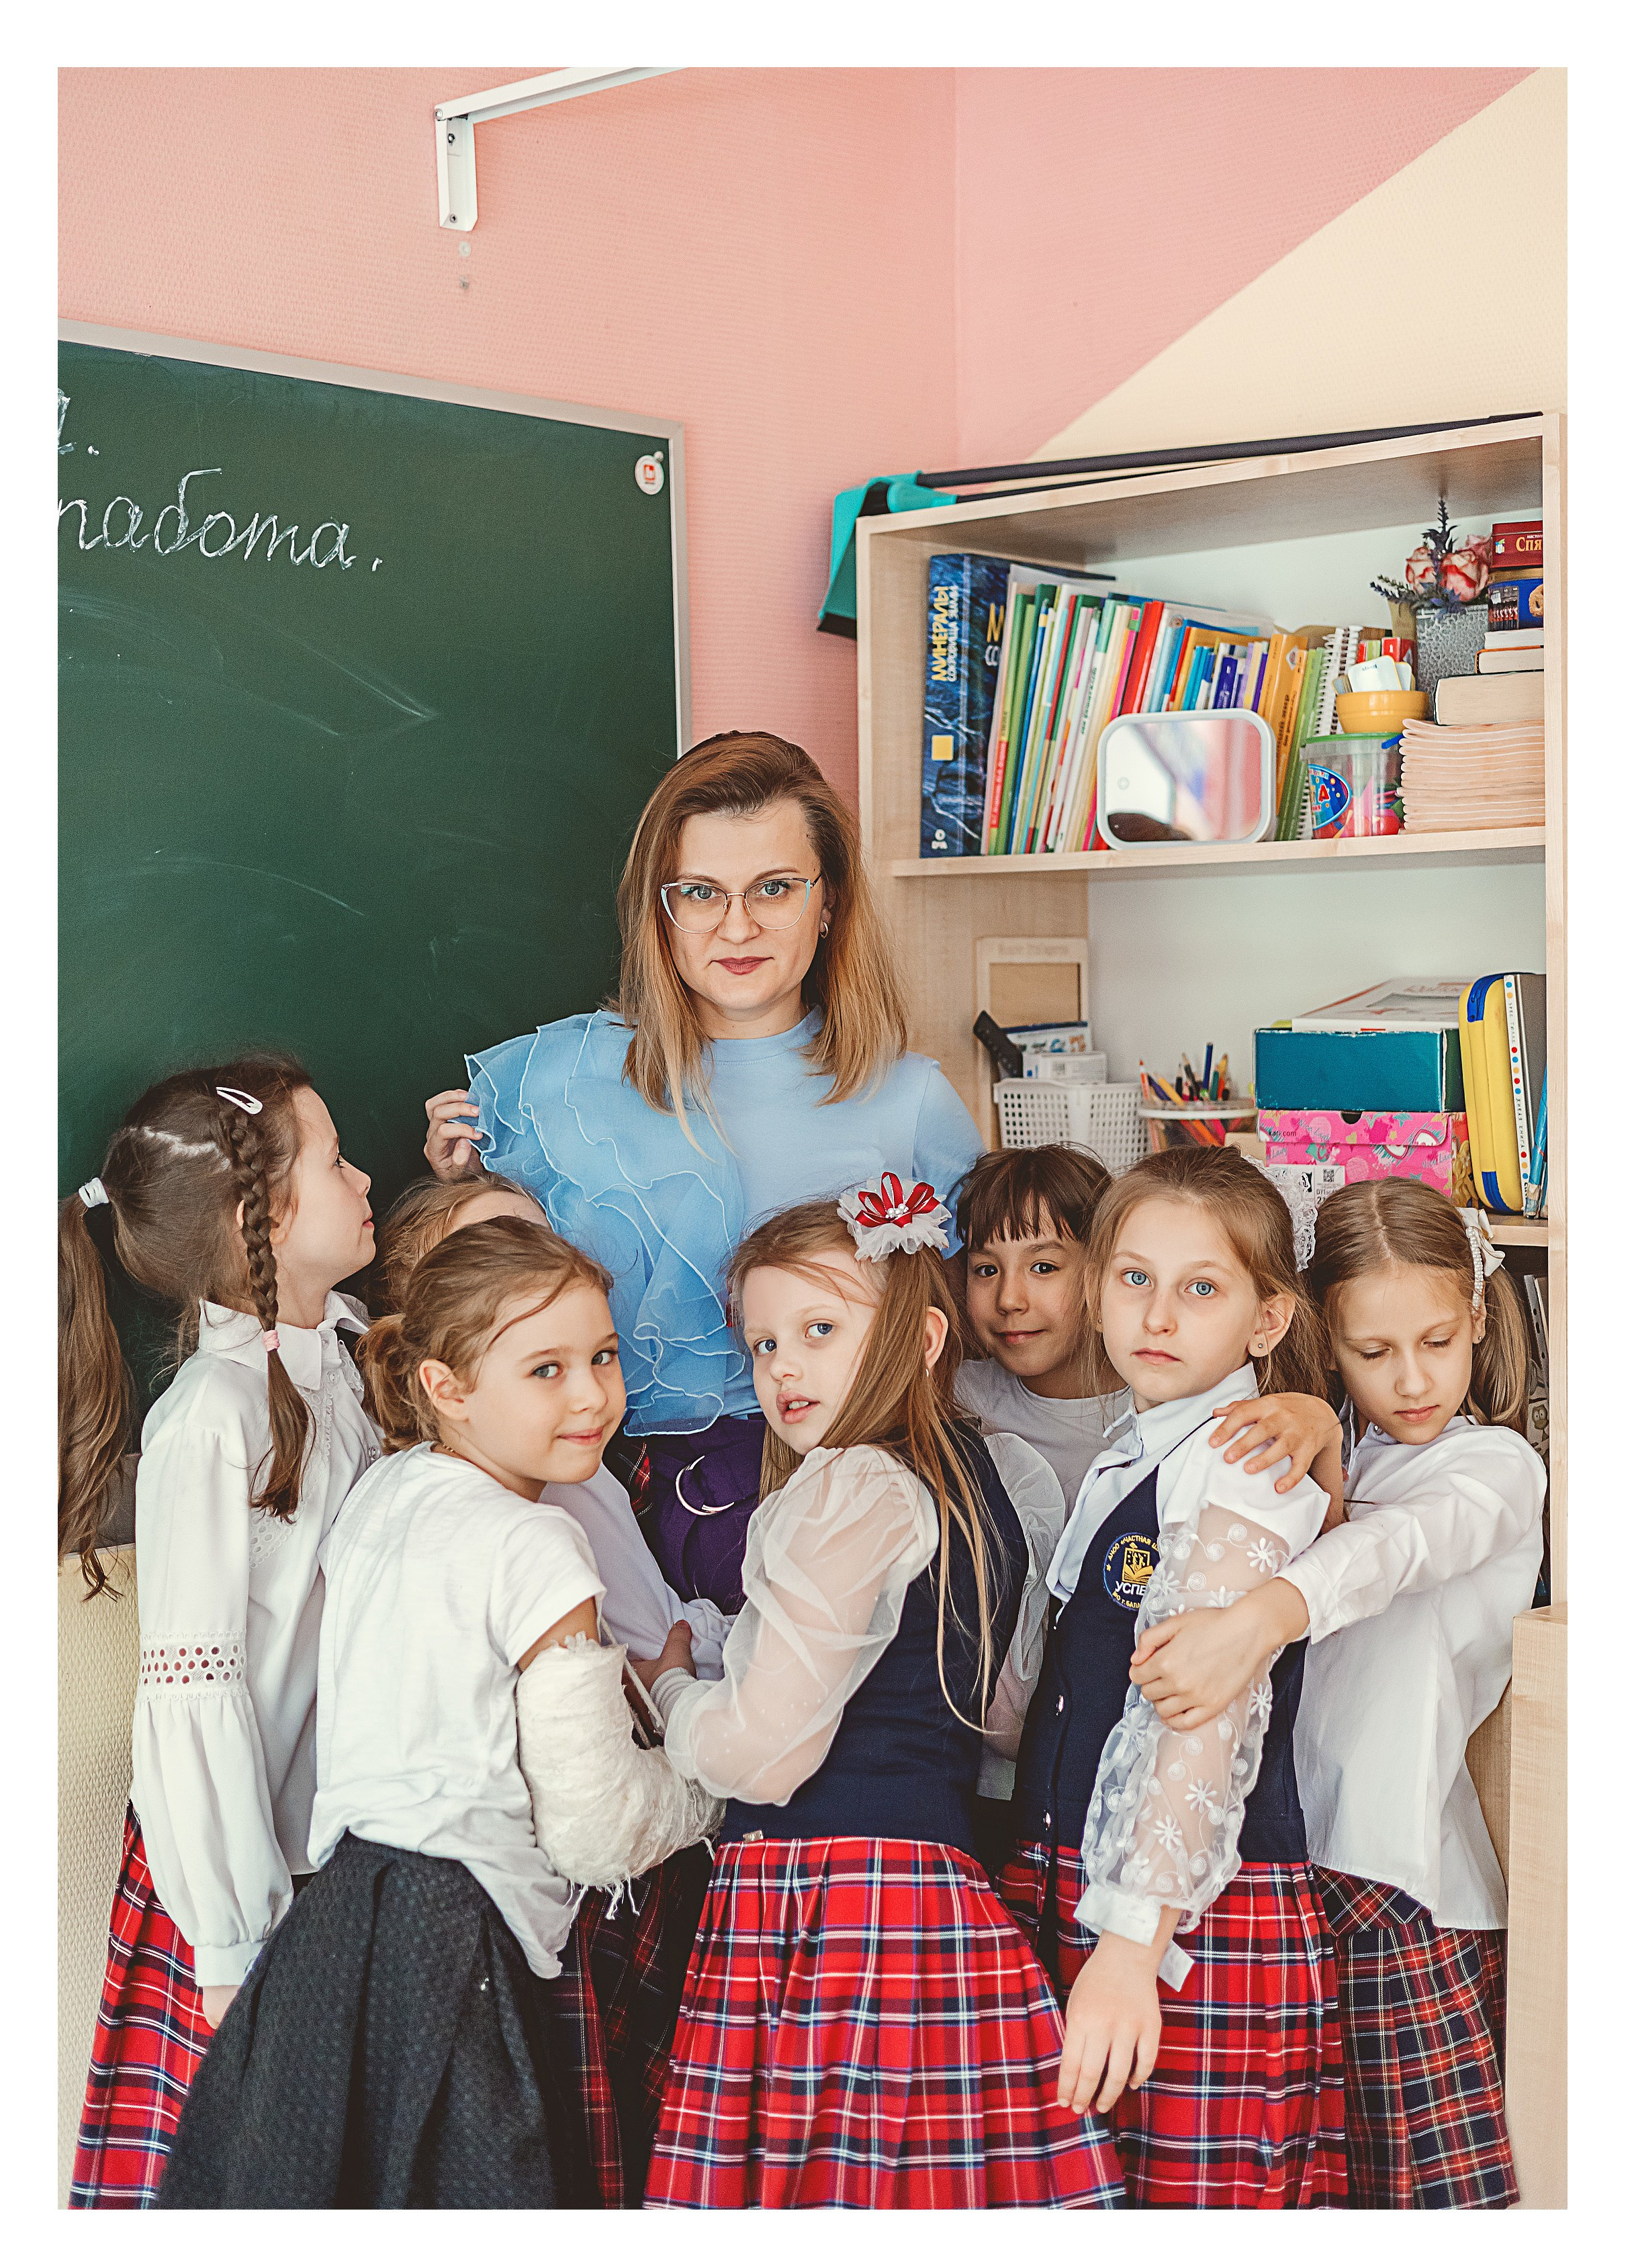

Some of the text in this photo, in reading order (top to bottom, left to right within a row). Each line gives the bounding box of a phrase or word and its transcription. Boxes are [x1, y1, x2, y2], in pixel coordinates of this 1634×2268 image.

[931, 586, 950, 682] МИНЕРАЛЫ
[946, 622, 960, 682] СОКРОВИЩА
[1108, 1543, 1120, 1562] АНОО
